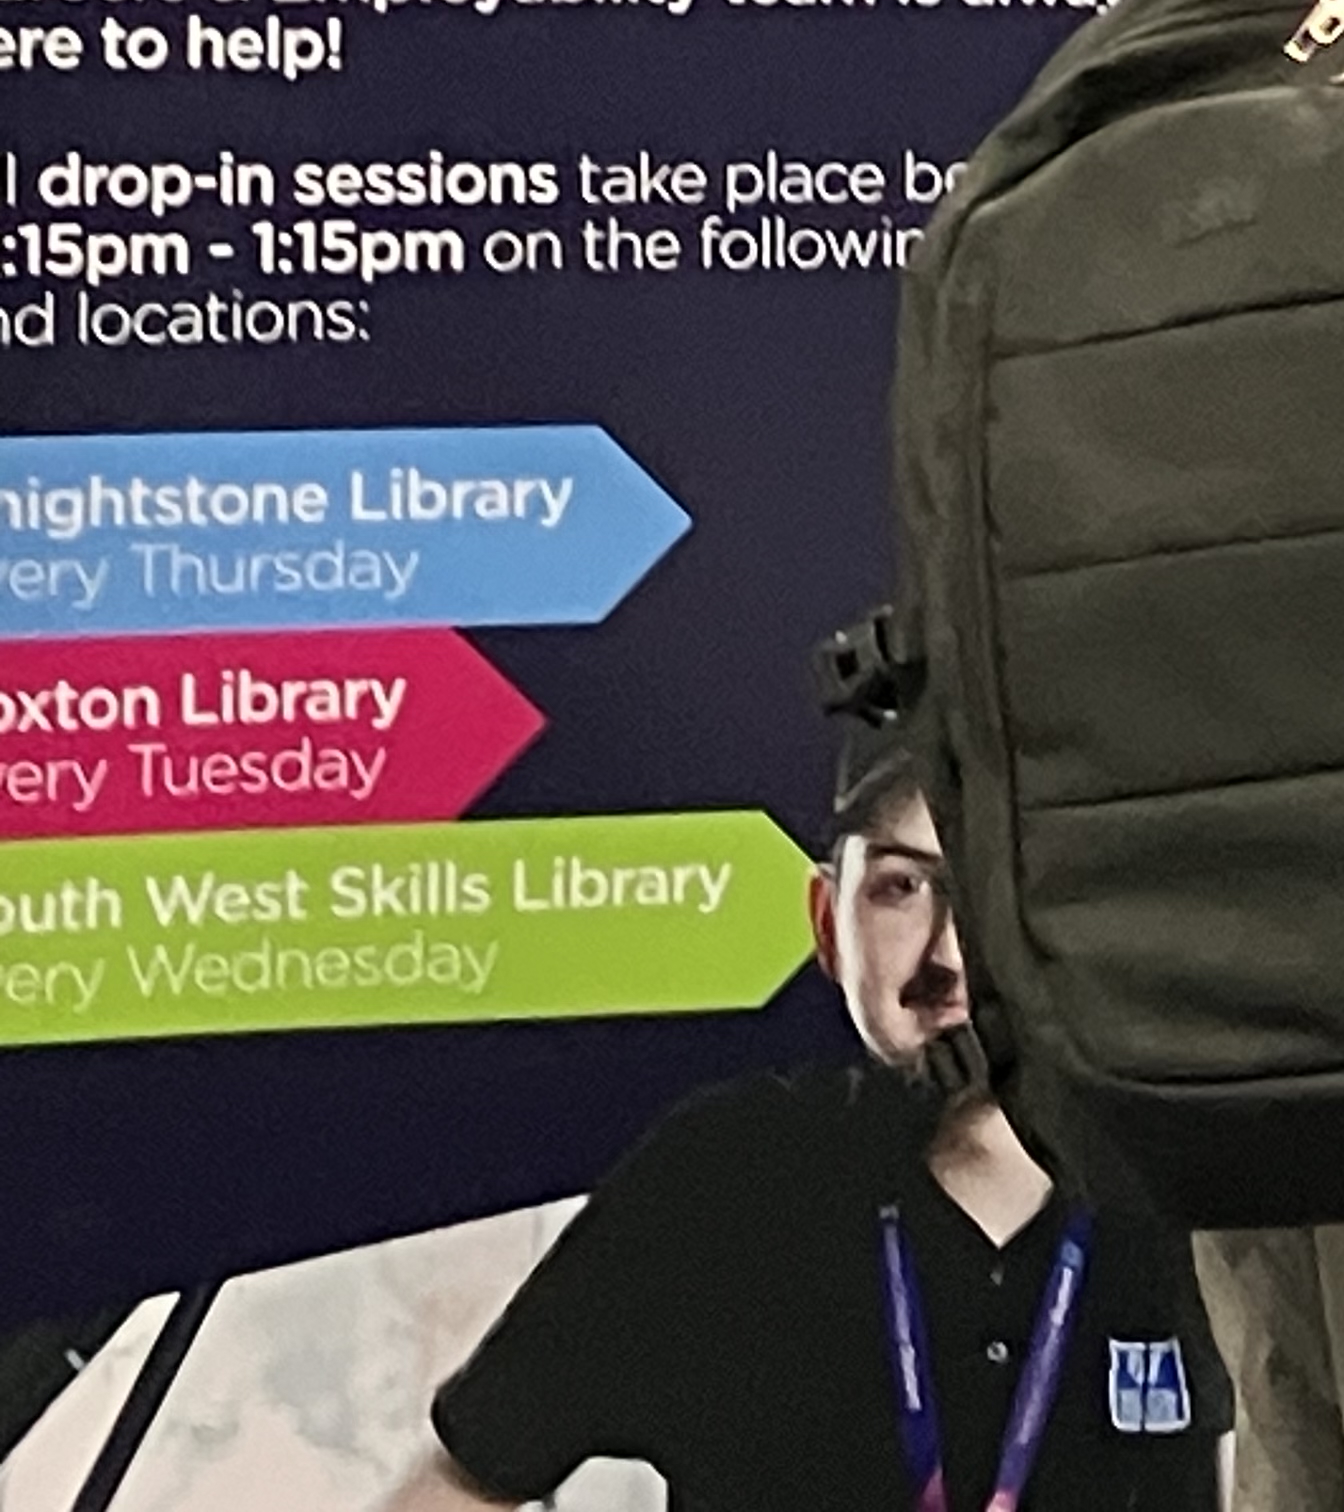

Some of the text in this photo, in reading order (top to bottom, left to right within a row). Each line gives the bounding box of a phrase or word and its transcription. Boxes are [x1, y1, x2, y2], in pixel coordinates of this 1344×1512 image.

[101, 17, 168, 69] to
[188, 15, 341, 80] help!
[39, 152, 273, 216] drop-in
[294, 150, 559, 205] sessions
[580, 151, 707, 203] take
[727, 150, 885, 213] place
[2, 223, 188, 287] :15pm
[209, 244, 233, 257] -
[252, 222, 463, 284] 1:15pm
[484, 231, 562, 271] on
[583, 218, 680, 270] the
[79, 289, 369, 344] locations:
[0, 468, 572, 539] nightstone Library
[0, 540, 418, 608] ery Thursday
[0, 669, 406, 732] xton Library
[0, 737, 385, 811] ery Tuesday
[0, 856, 730, 934] uth West Skills Library
[0, 929, 498, 1012] ery Wednesday
